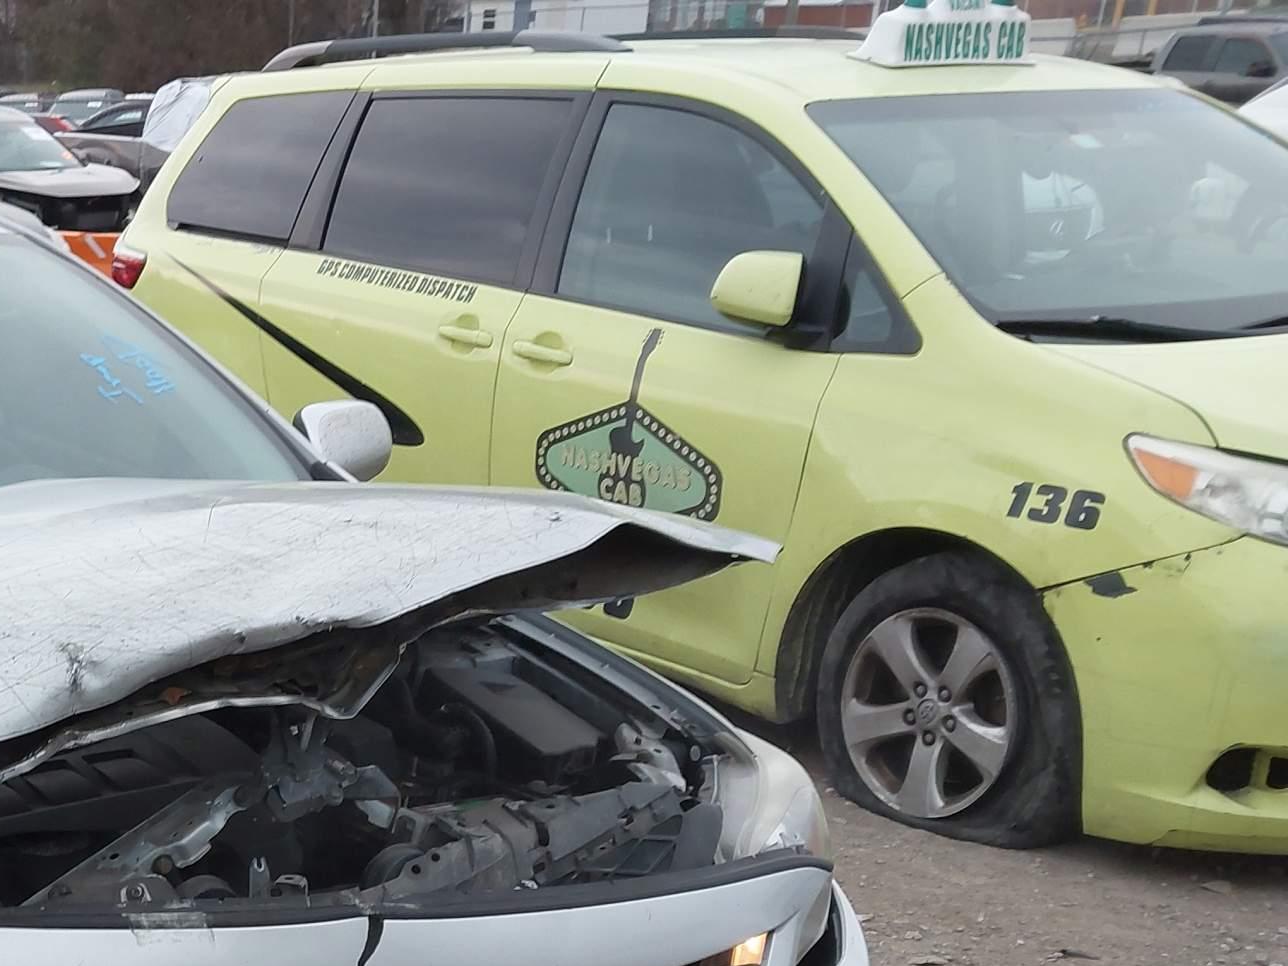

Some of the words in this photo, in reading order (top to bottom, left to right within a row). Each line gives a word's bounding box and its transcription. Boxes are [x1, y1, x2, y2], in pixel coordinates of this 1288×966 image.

[903, 22, 991, 62] NASHVEGAS
[996, 21, 1027, 60] CAB
[316, 258, 342, 276] GPS
[338, 262, 419, 293] COMPUTERIZED
[415, 276, 480, 304] DISPATCH
[561, 445, 693, 492] NASHVEGAS
[599, 477, 643, 508] CAB
[1006, 481, 1107, 530] 136
